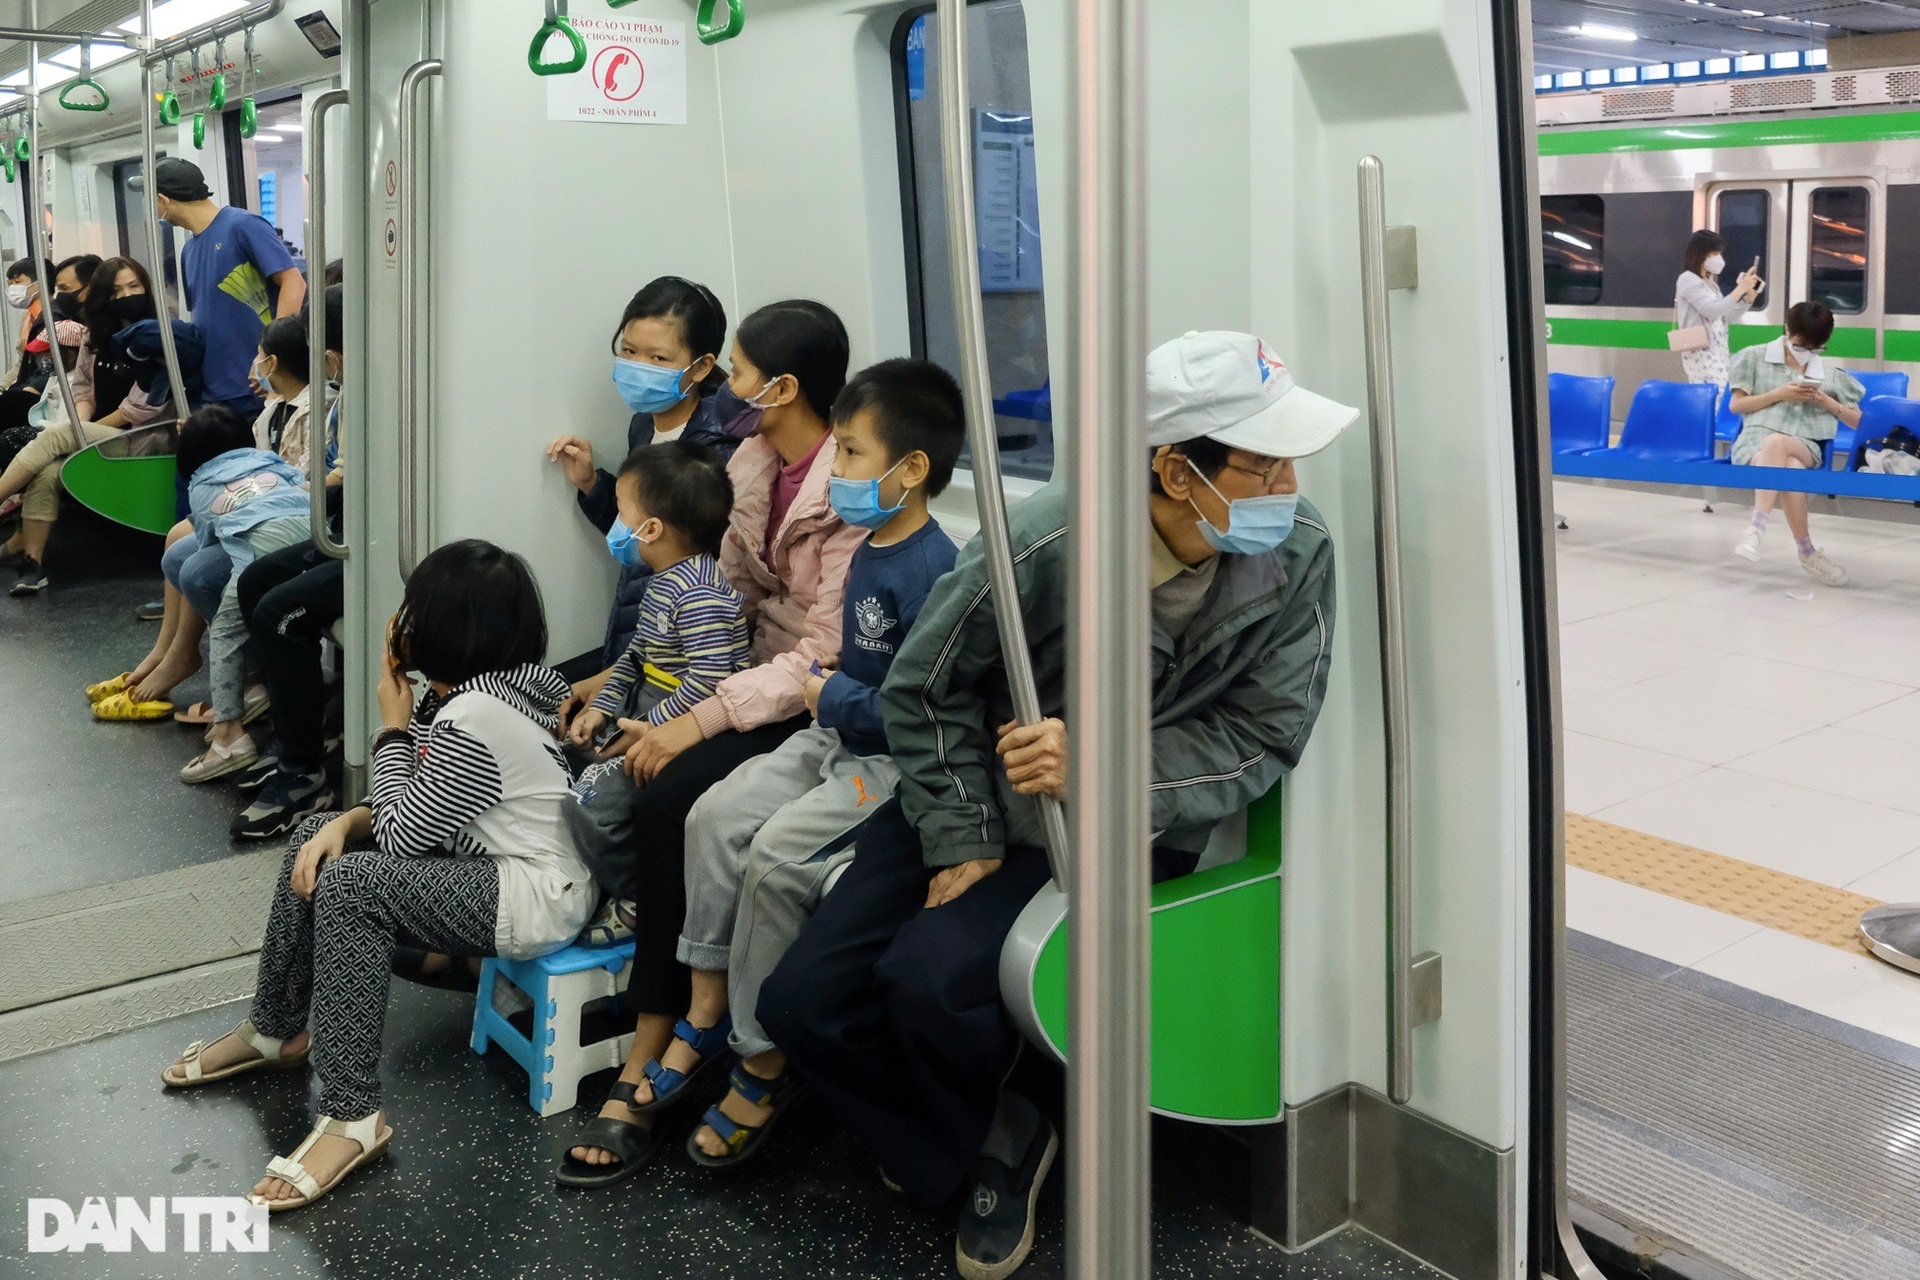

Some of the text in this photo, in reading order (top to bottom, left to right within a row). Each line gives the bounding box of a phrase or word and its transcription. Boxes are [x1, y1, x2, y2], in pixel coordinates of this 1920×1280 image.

[595, 19, 618, 30] CÁO
[620, 22, 631, 31] VI
[634, 23, 663, 34] PHẠM
[620, 35, 641, 44] DỊCH
[643, 36, 670, 46] COVID
[578, 107, 595, 115] 1022
